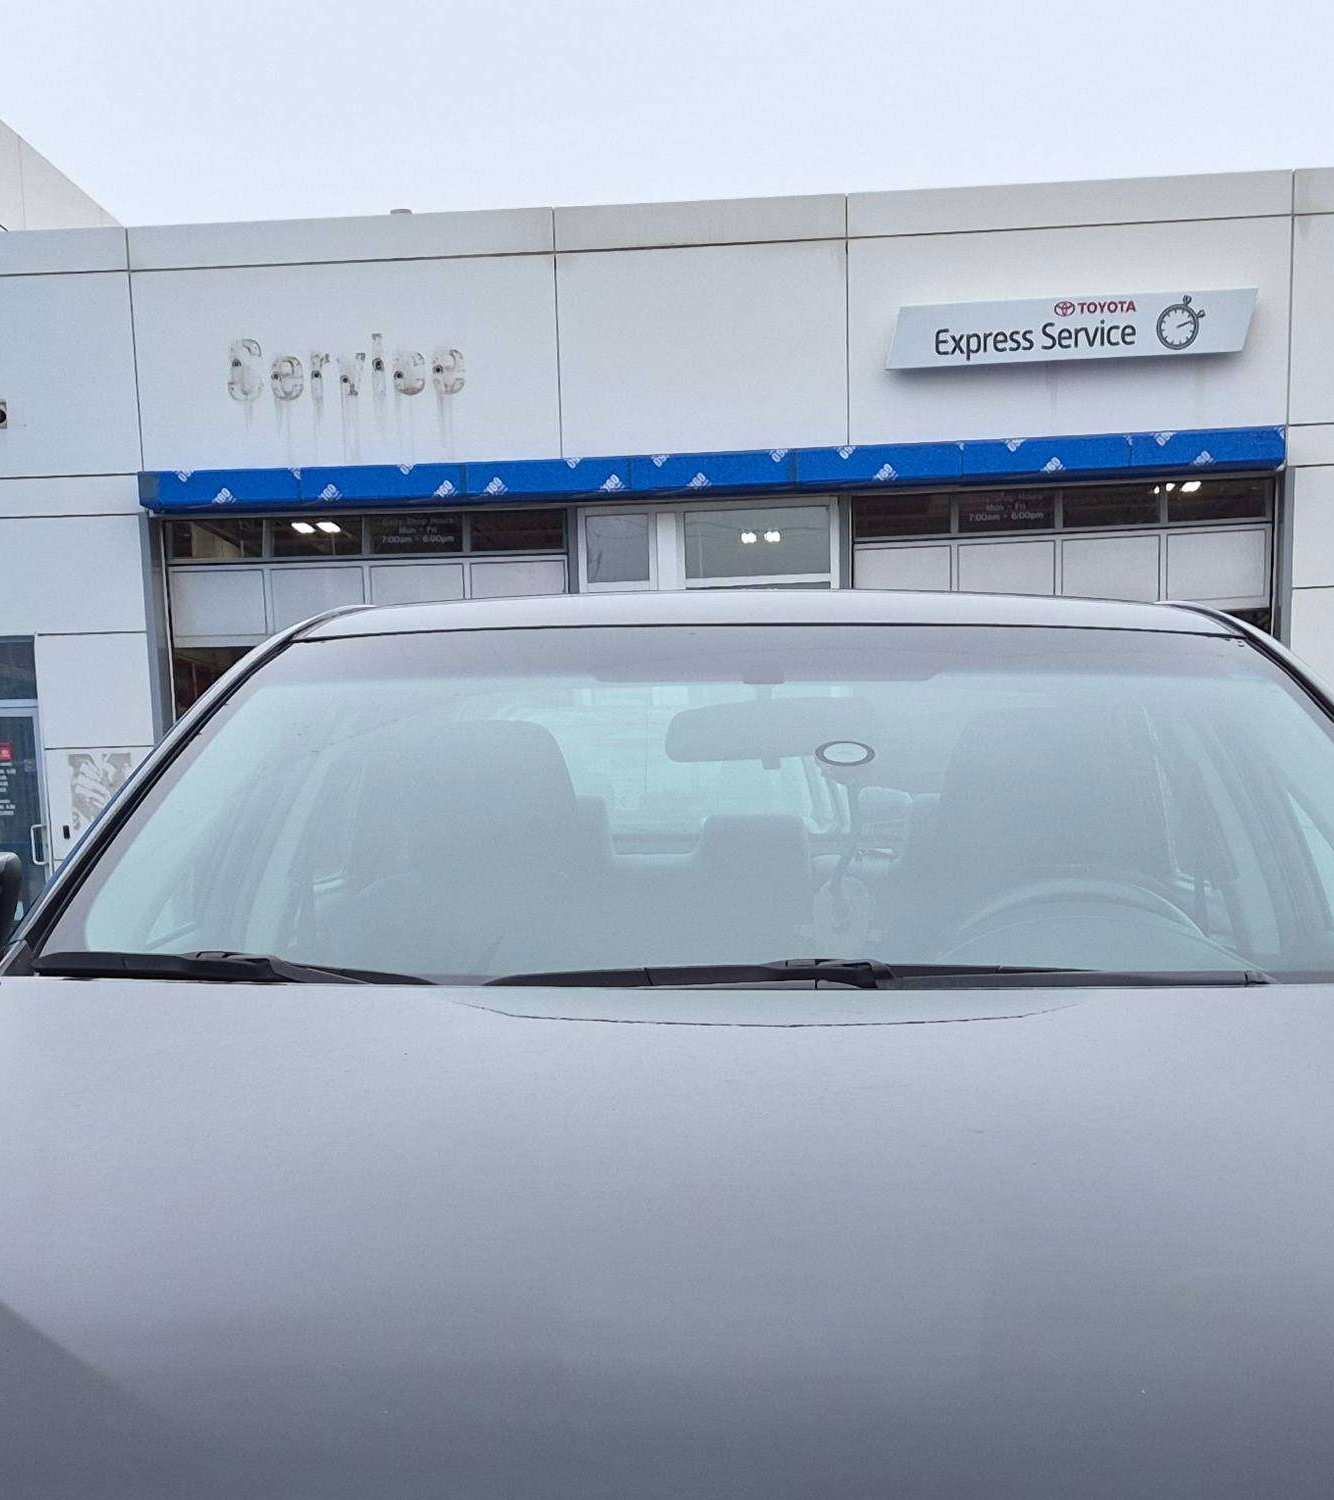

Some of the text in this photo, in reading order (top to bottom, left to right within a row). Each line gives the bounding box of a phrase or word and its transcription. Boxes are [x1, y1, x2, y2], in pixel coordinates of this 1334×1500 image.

[1078, 300, 1137, 315] TOYOTA
[934, 318, 1137, 361] Express Service
